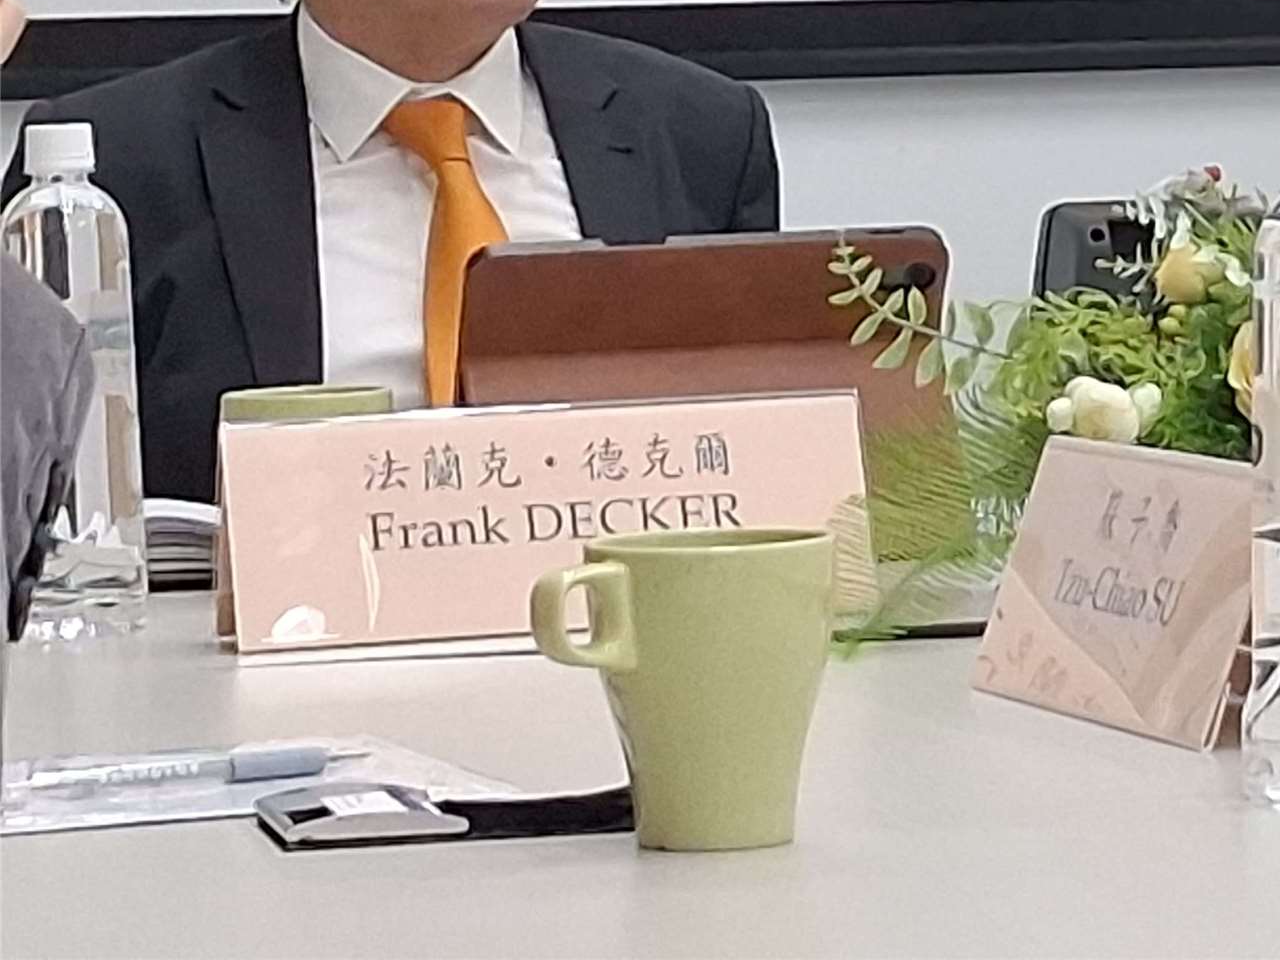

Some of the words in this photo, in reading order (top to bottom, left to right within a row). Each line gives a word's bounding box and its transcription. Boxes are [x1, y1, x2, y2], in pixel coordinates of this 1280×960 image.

[367, 504, 510, 552] Frank
[522, 492, 742, 542] DECKER
[1146, 576, 1187, 627] SU
